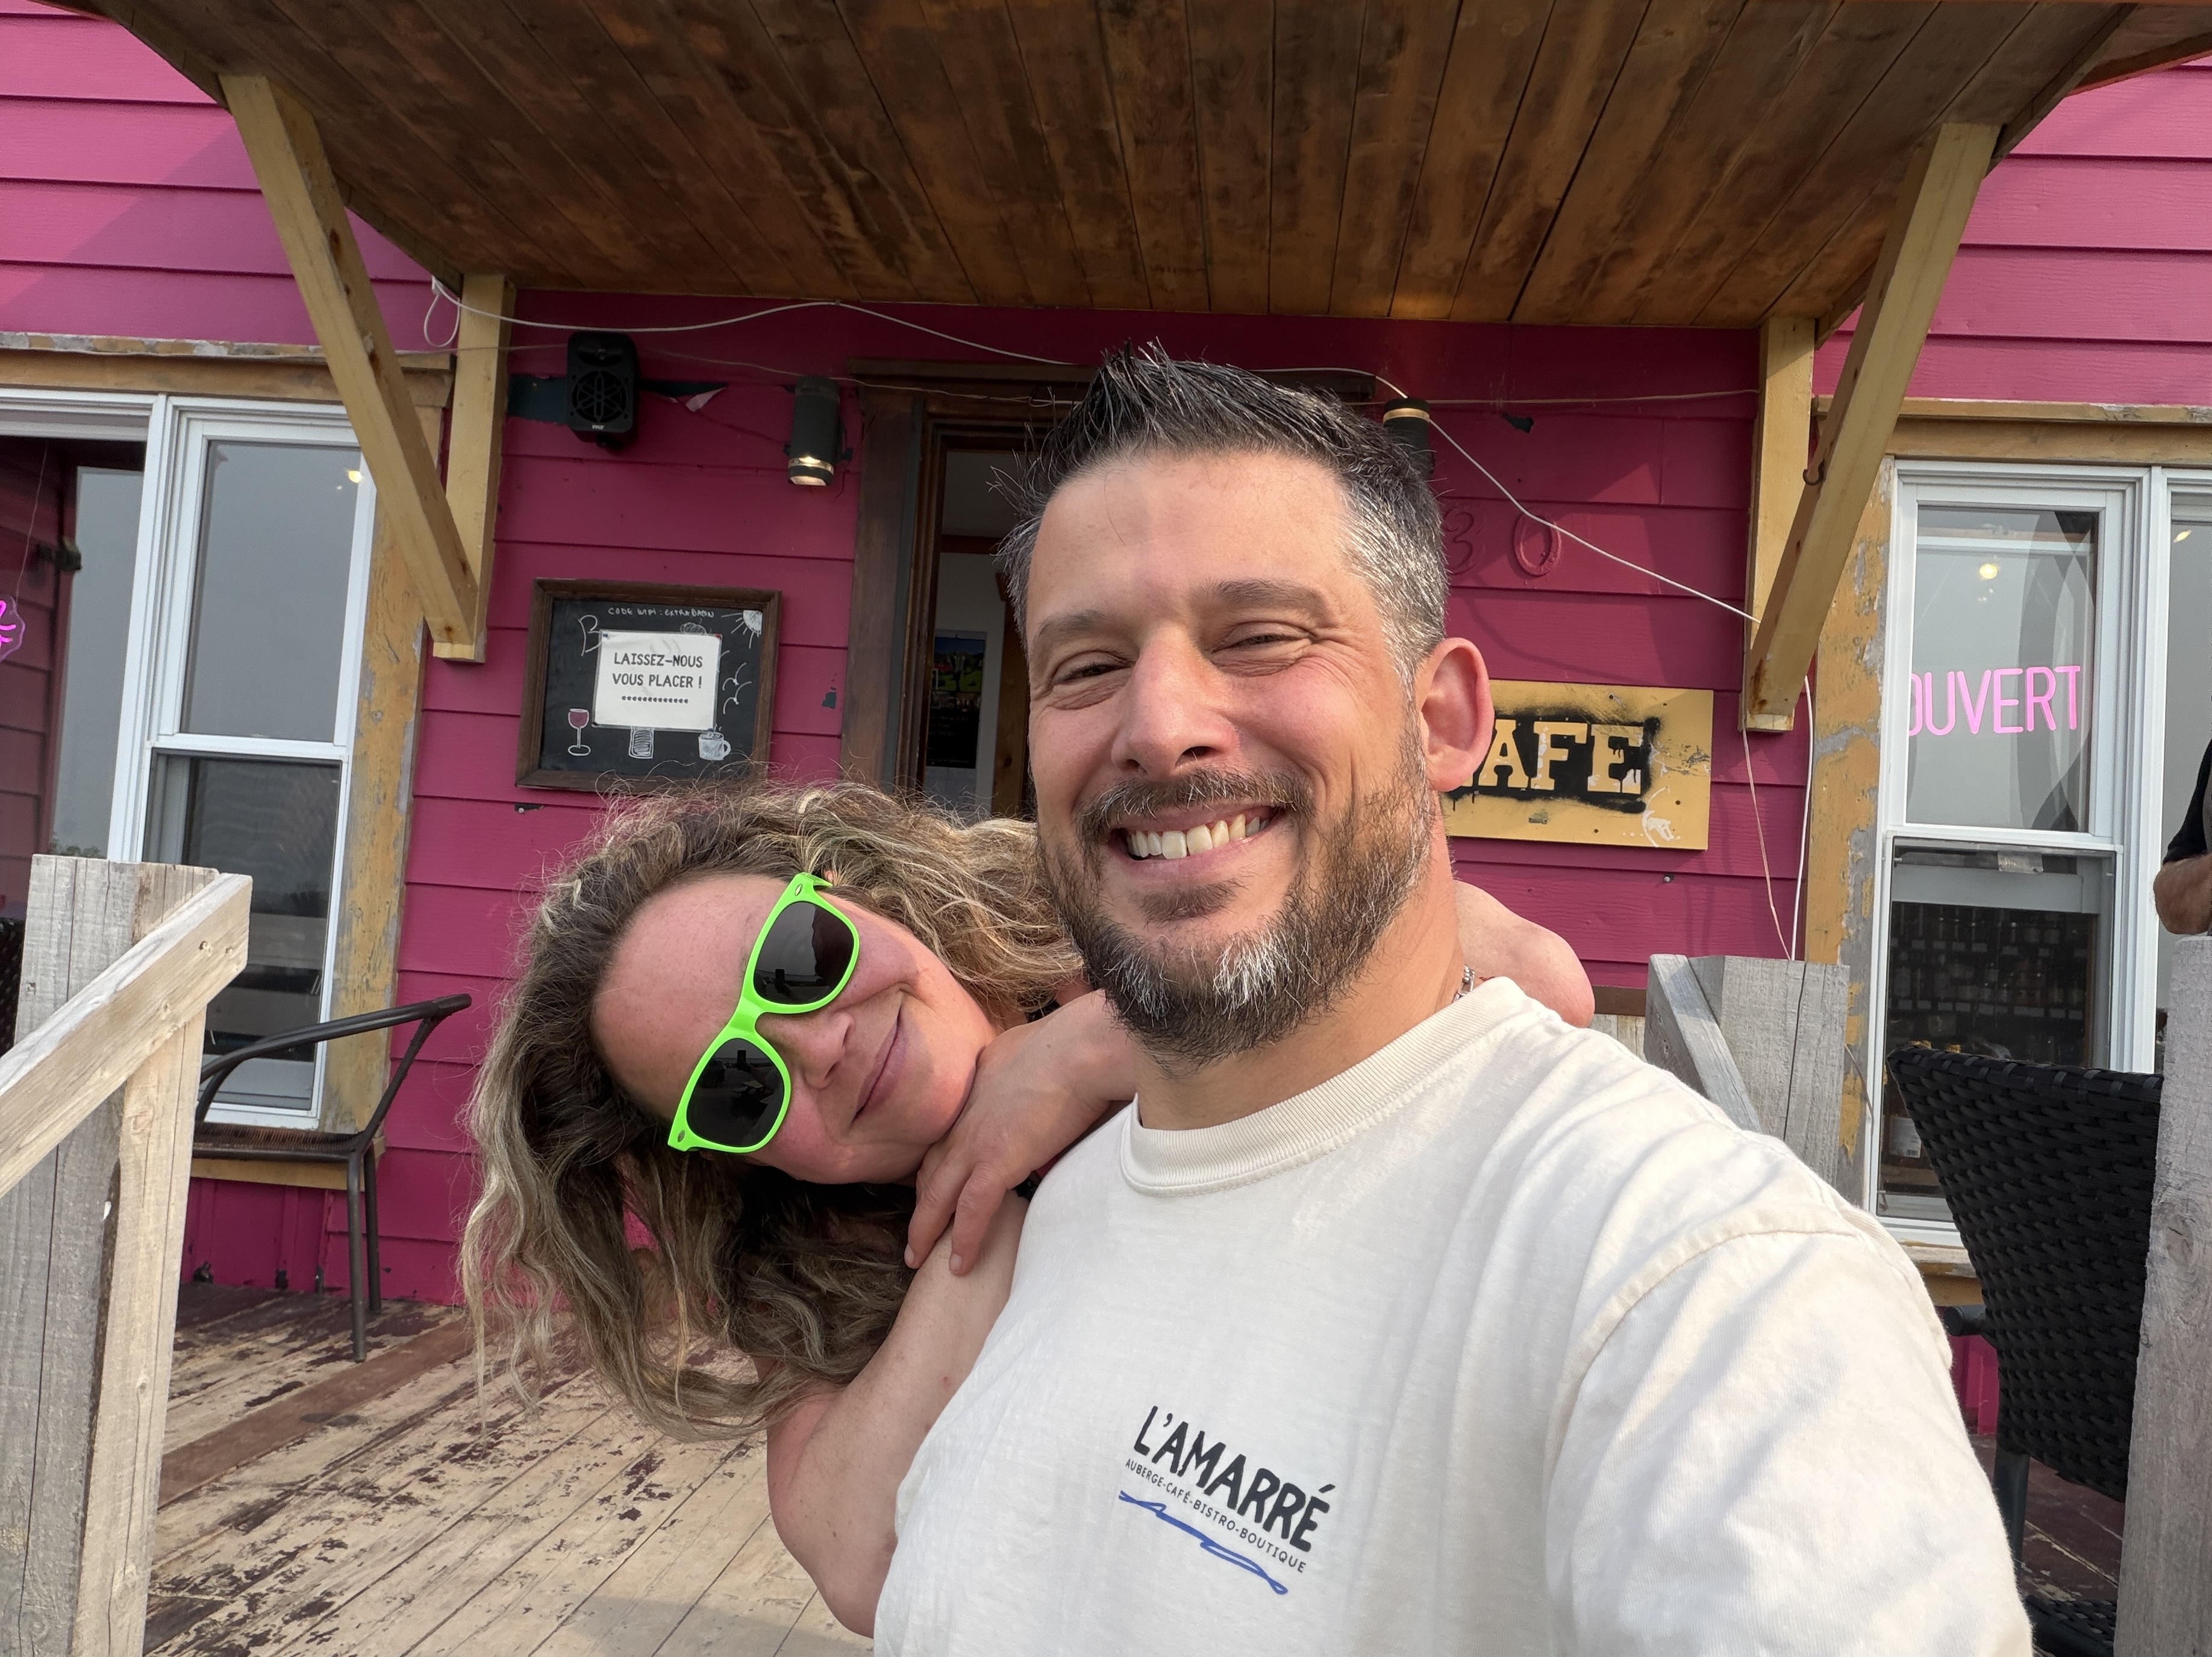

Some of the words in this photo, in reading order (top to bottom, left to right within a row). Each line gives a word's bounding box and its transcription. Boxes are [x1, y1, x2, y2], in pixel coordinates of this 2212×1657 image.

[612, 673, 644, 686] VOUS
[649, 674, 693, 688] PLACER
[614, 652, 703, 668] LAISSEZ-NOUS
[1461, 718, 1644, 794] AFE
[1133, 1405, 1336, 1553] L'AMARRÉ
